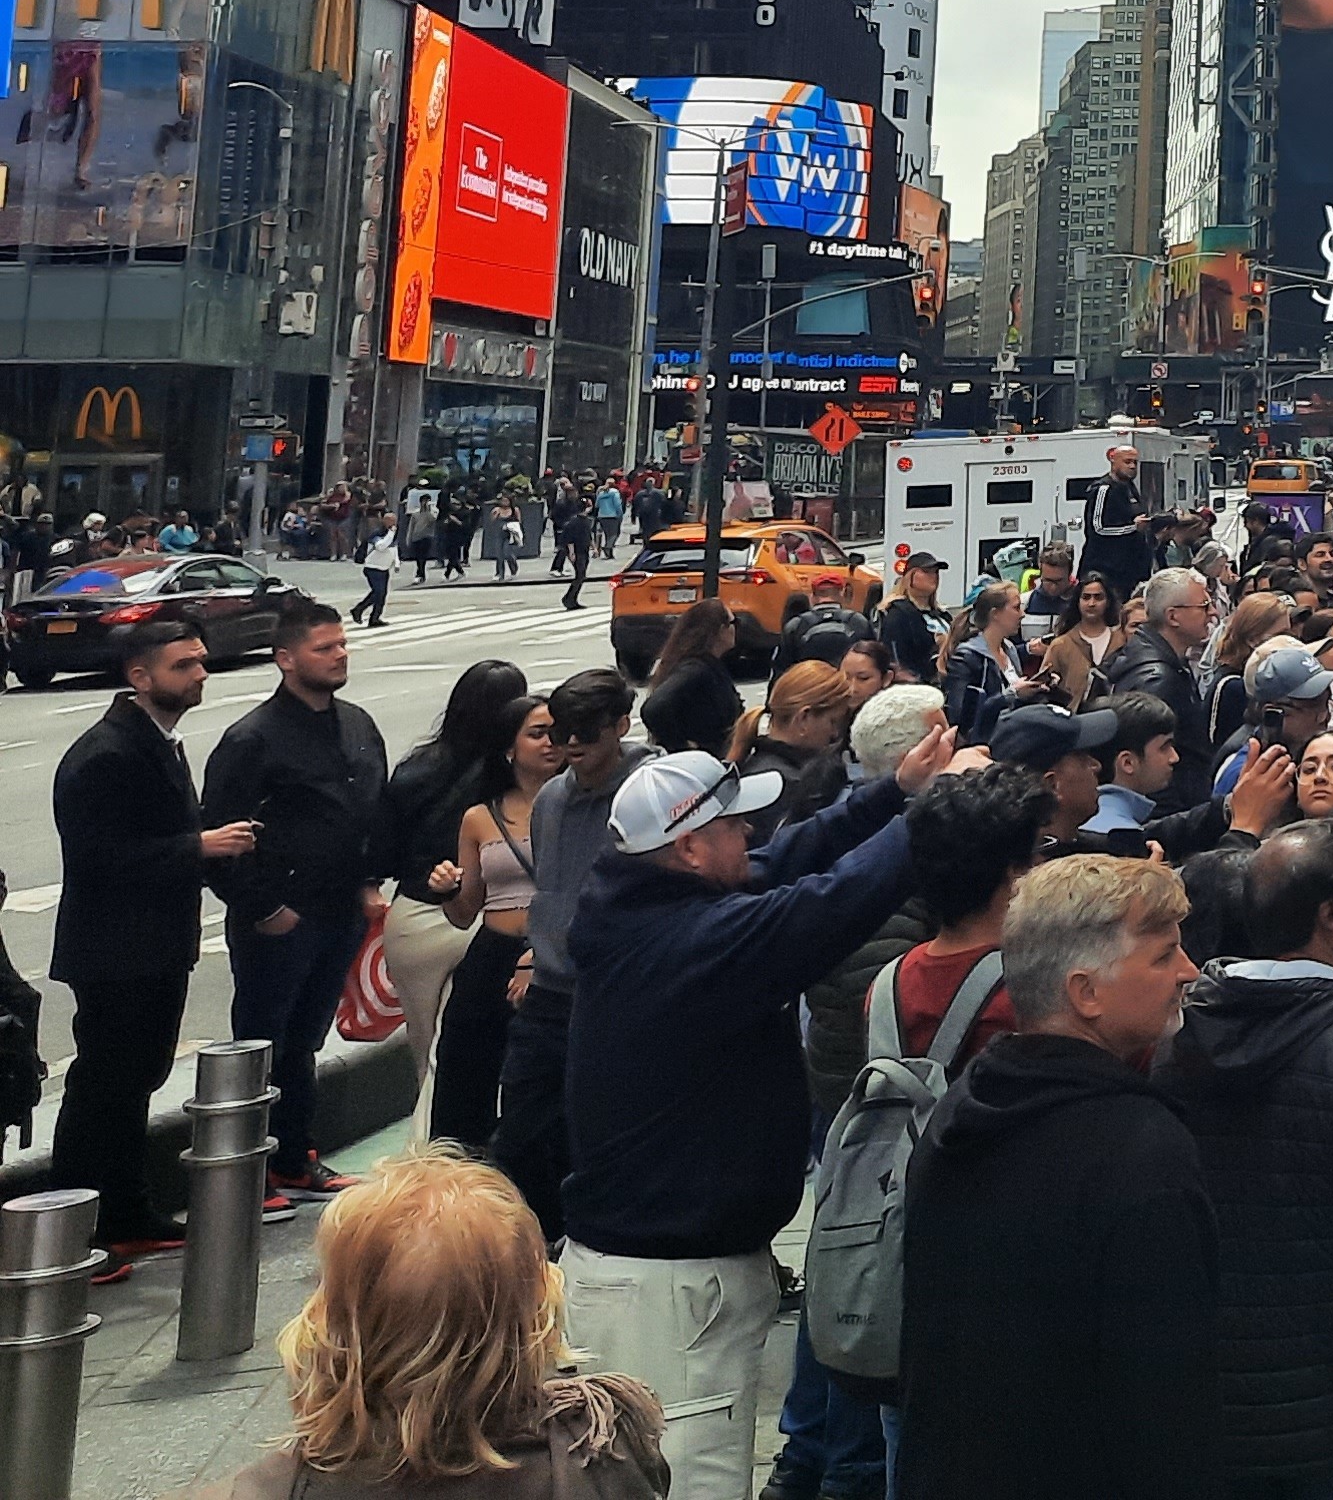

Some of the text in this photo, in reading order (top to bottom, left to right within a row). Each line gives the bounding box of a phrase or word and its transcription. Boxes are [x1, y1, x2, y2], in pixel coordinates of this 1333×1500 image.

[580, 227, 638, 289] OLD NAVY
[772, 454, 844, 483] BROADWAY'S
